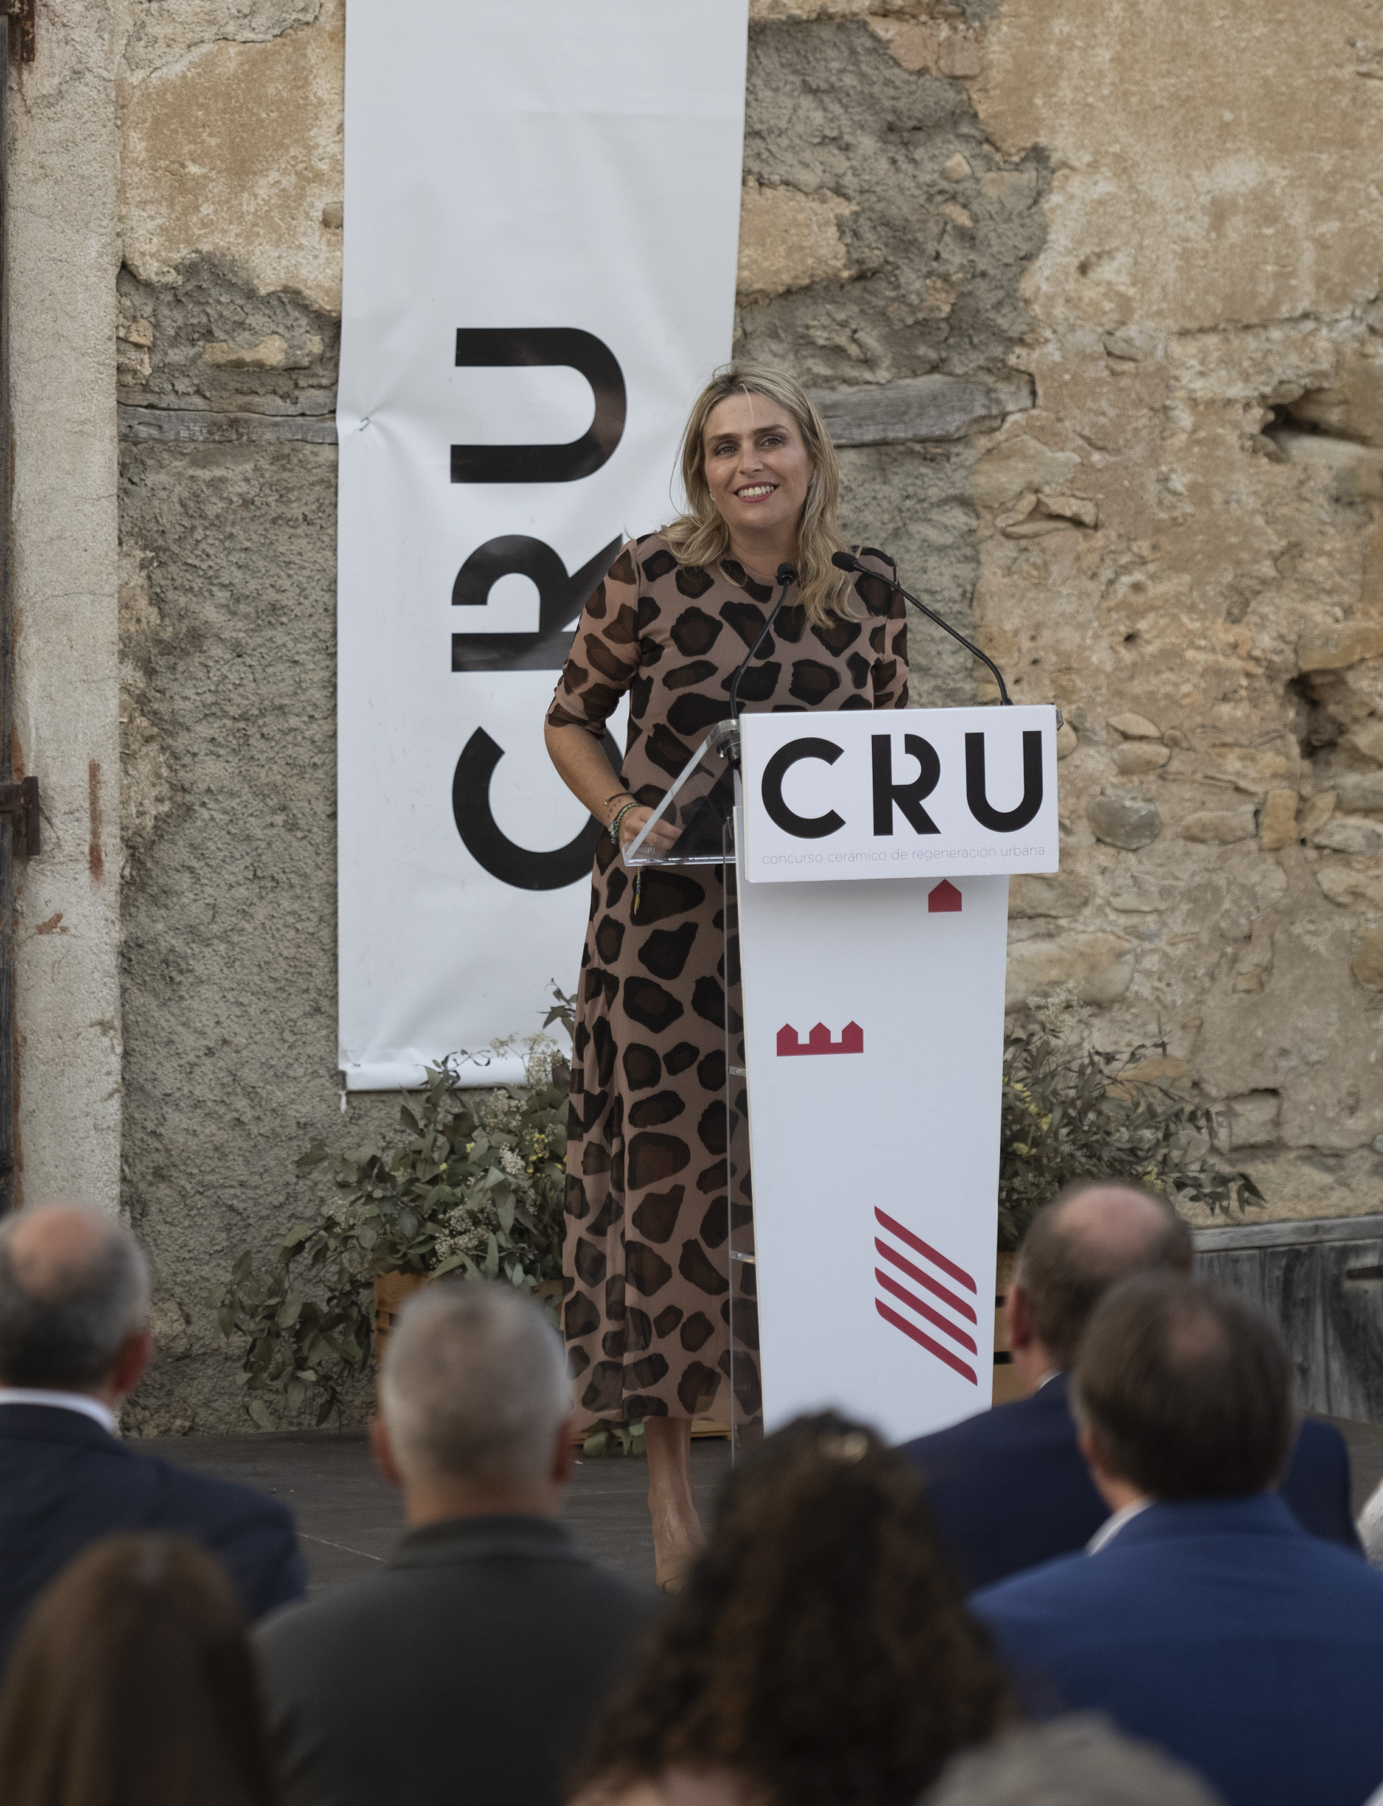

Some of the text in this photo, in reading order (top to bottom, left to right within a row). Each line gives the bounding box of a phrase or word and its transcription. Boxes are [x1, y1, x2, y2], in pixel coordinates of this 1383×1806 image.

[451, 327, 627, 891] CRU
[761, 730, 1043, 839] CRU
[762, 844, 1045, 865] concurso cerámico de regeneración urbana
